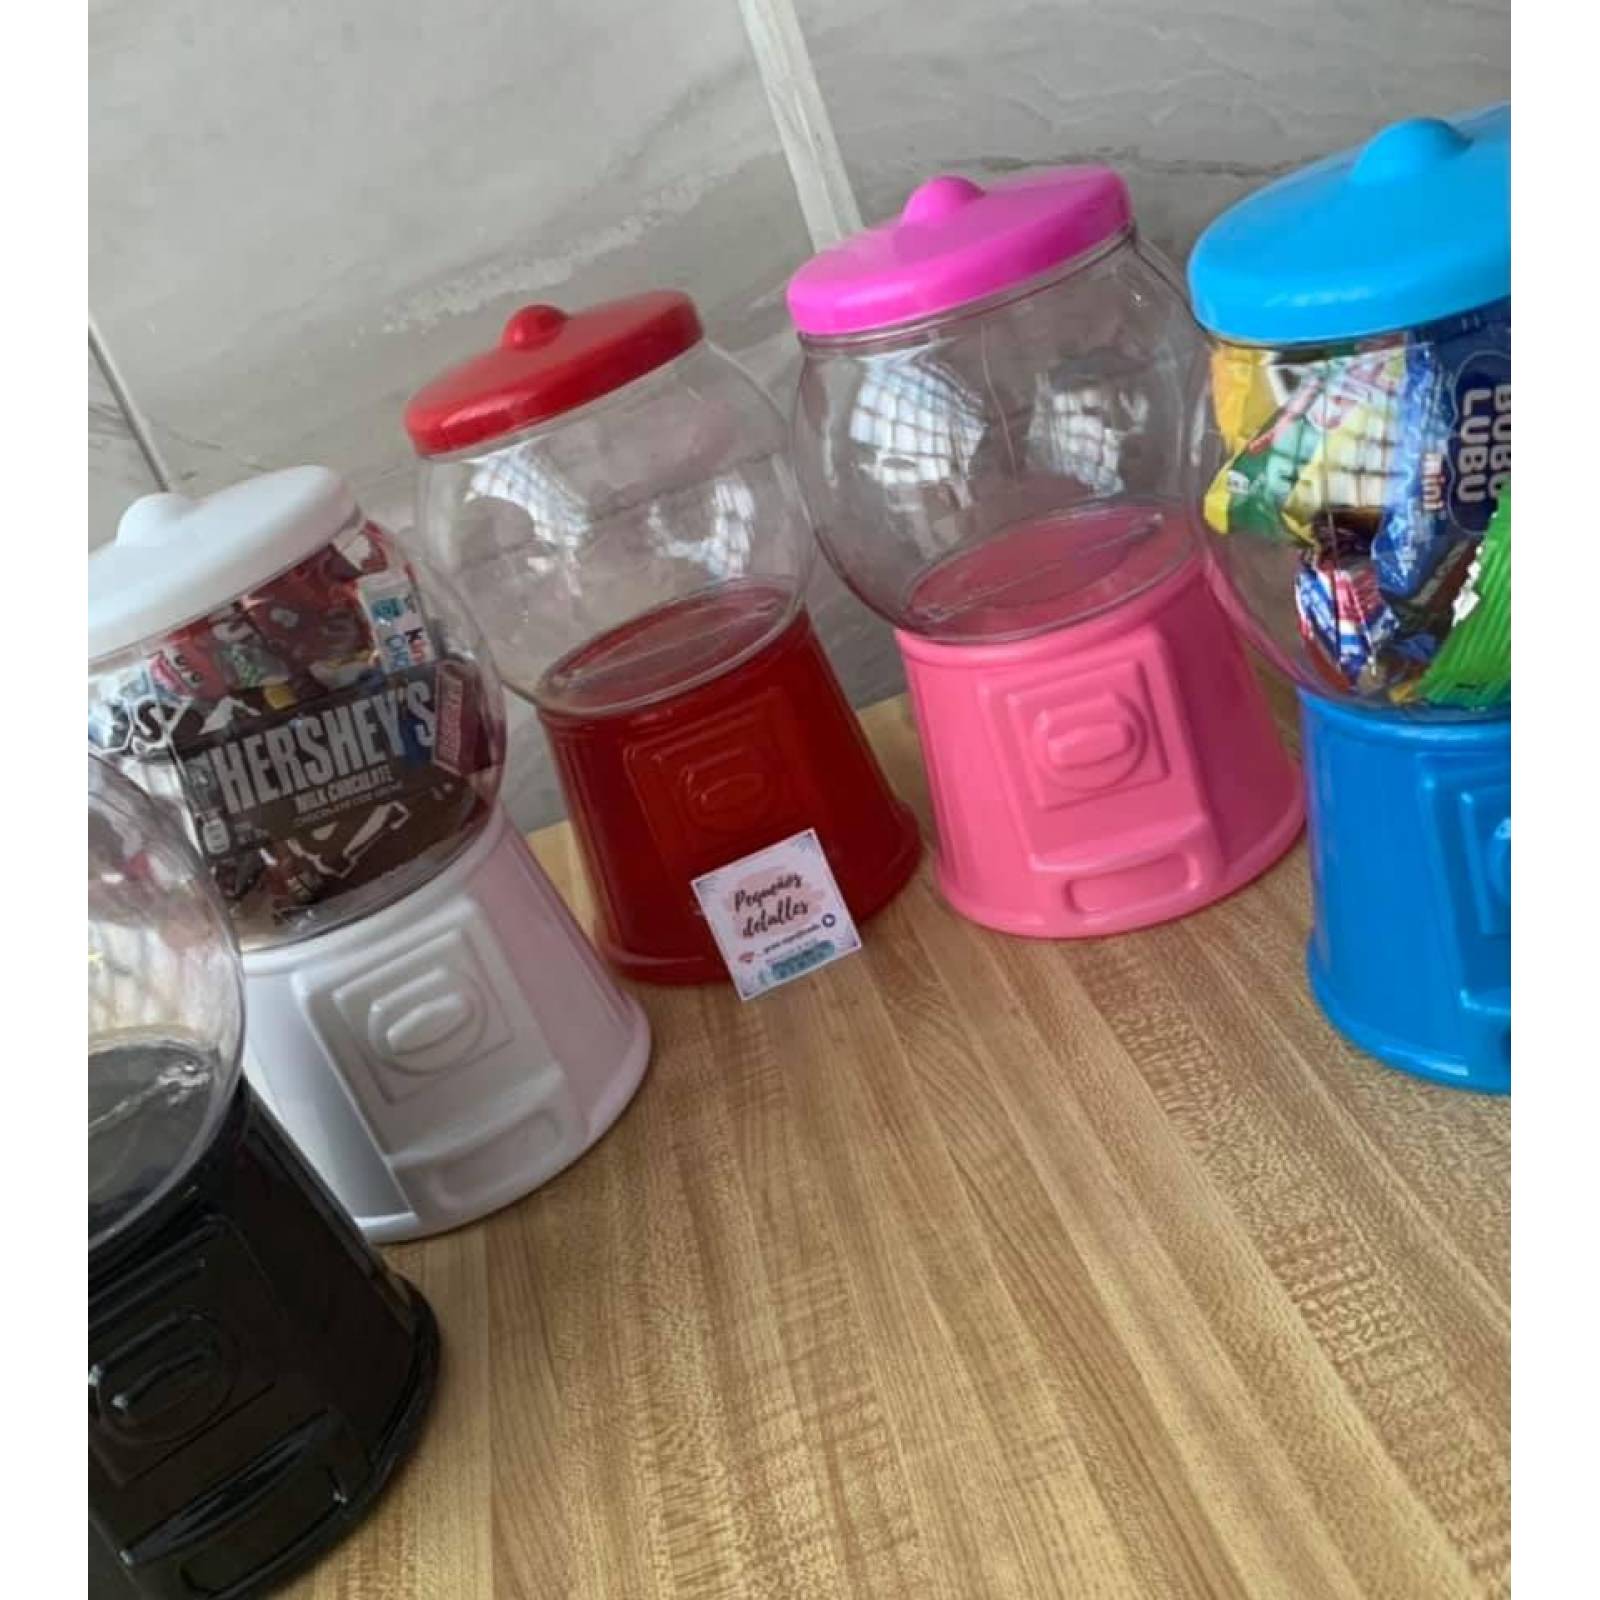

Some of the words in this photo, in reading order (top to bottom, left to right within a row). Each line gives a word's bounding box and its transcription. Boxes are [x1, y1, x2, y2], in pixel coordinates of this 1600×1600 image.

[1458, 388, 1492, 502] LUBU
[208, 681, 436, 814] HERSHEY'S
[327, 763, 394, 802] CHOCOLATE
